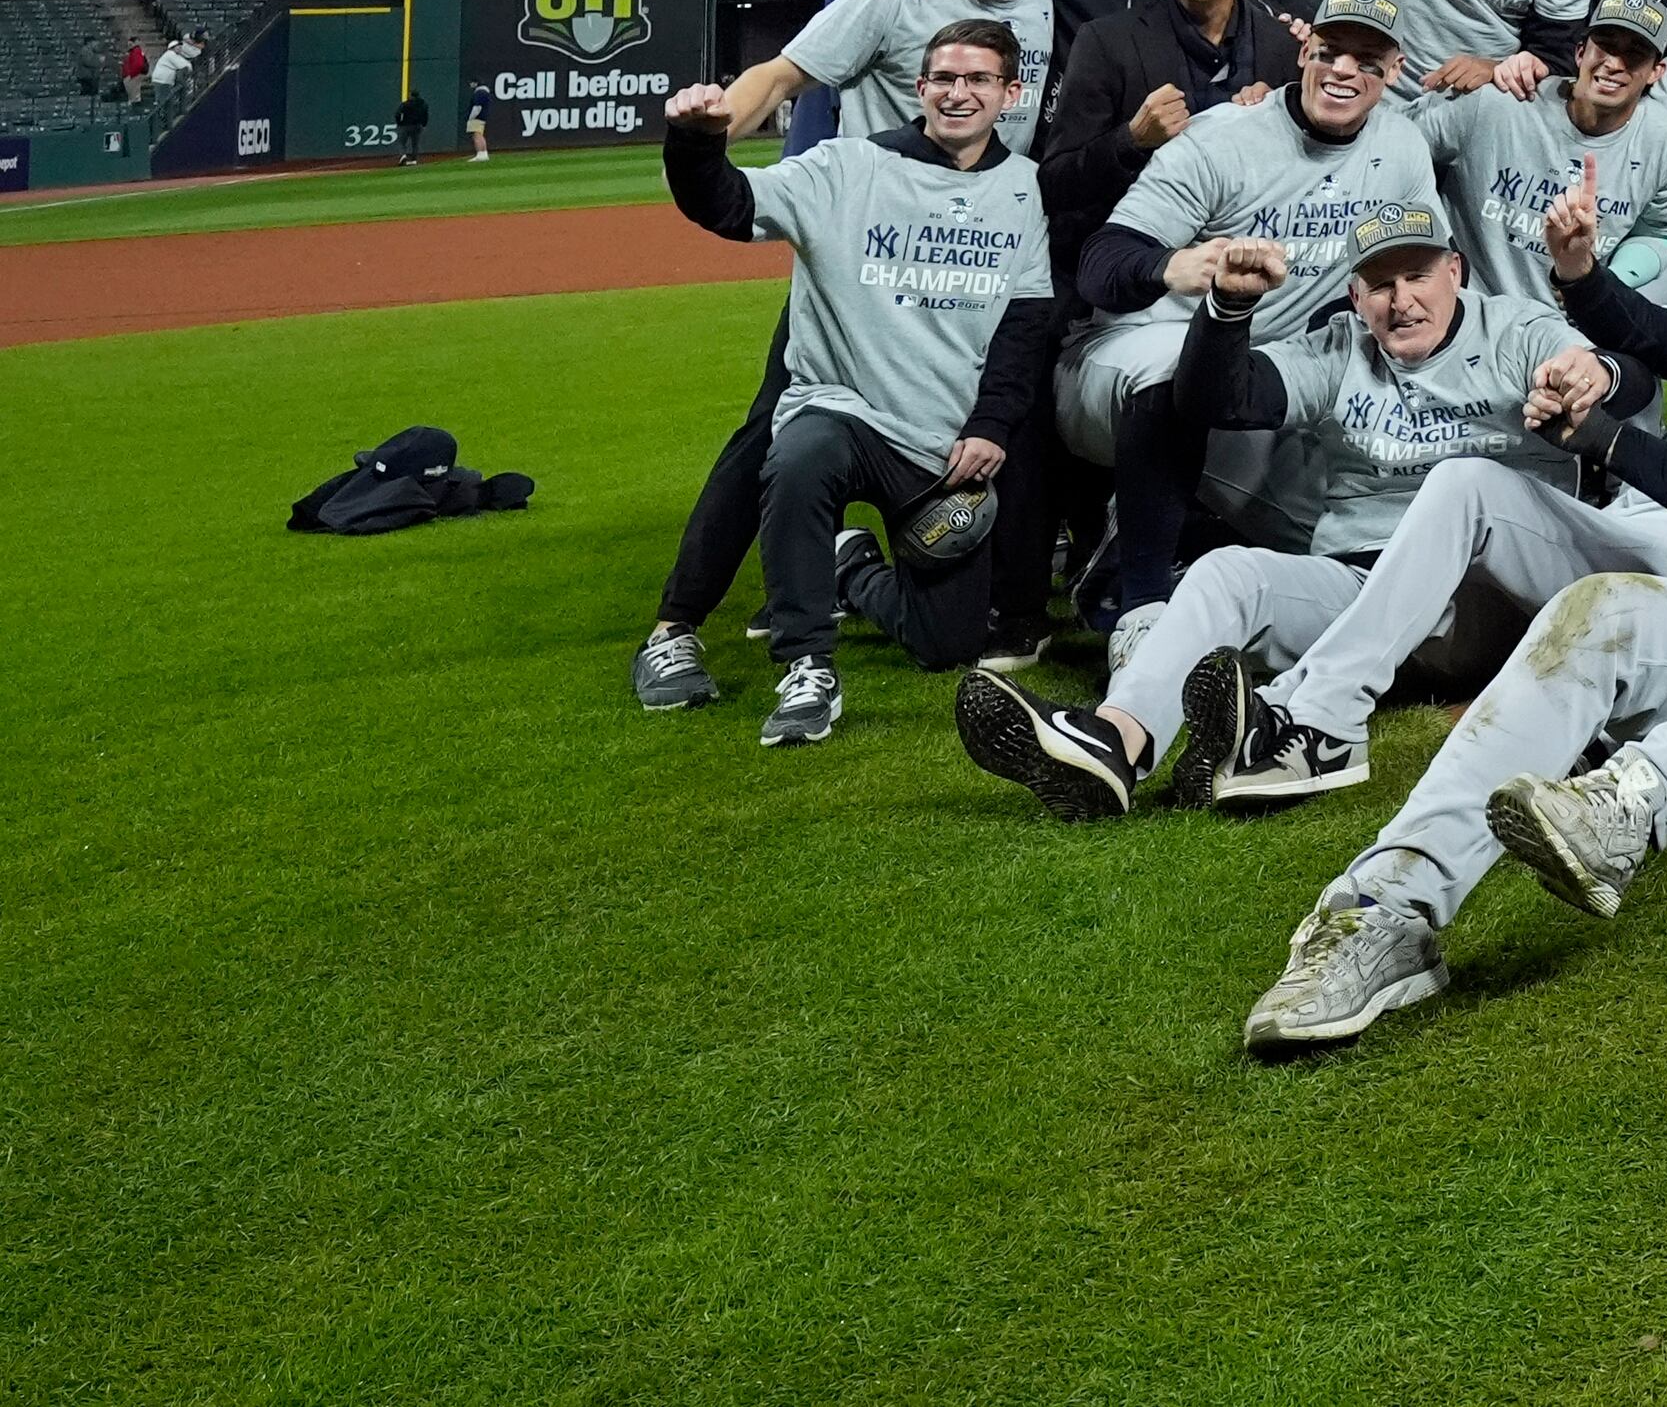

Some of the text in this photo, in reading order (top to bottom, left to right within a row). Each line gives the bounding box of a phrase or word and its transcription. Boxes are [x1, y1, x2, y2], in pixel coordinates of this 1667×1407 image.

[494, 68, 671, 101] Call before
[343, 123, 399, 147] 325
[521, 100, 644, 138] you dig.
[237, 118, 272, 157] GEICO
[912, 245, 1001, 269] LEAGUE
[859, 263, 1011, 295] CHAMPION
[1389, 399, 1494, 431] AMERICAN
[1384, 419, 1472, 444] LEAGUE
